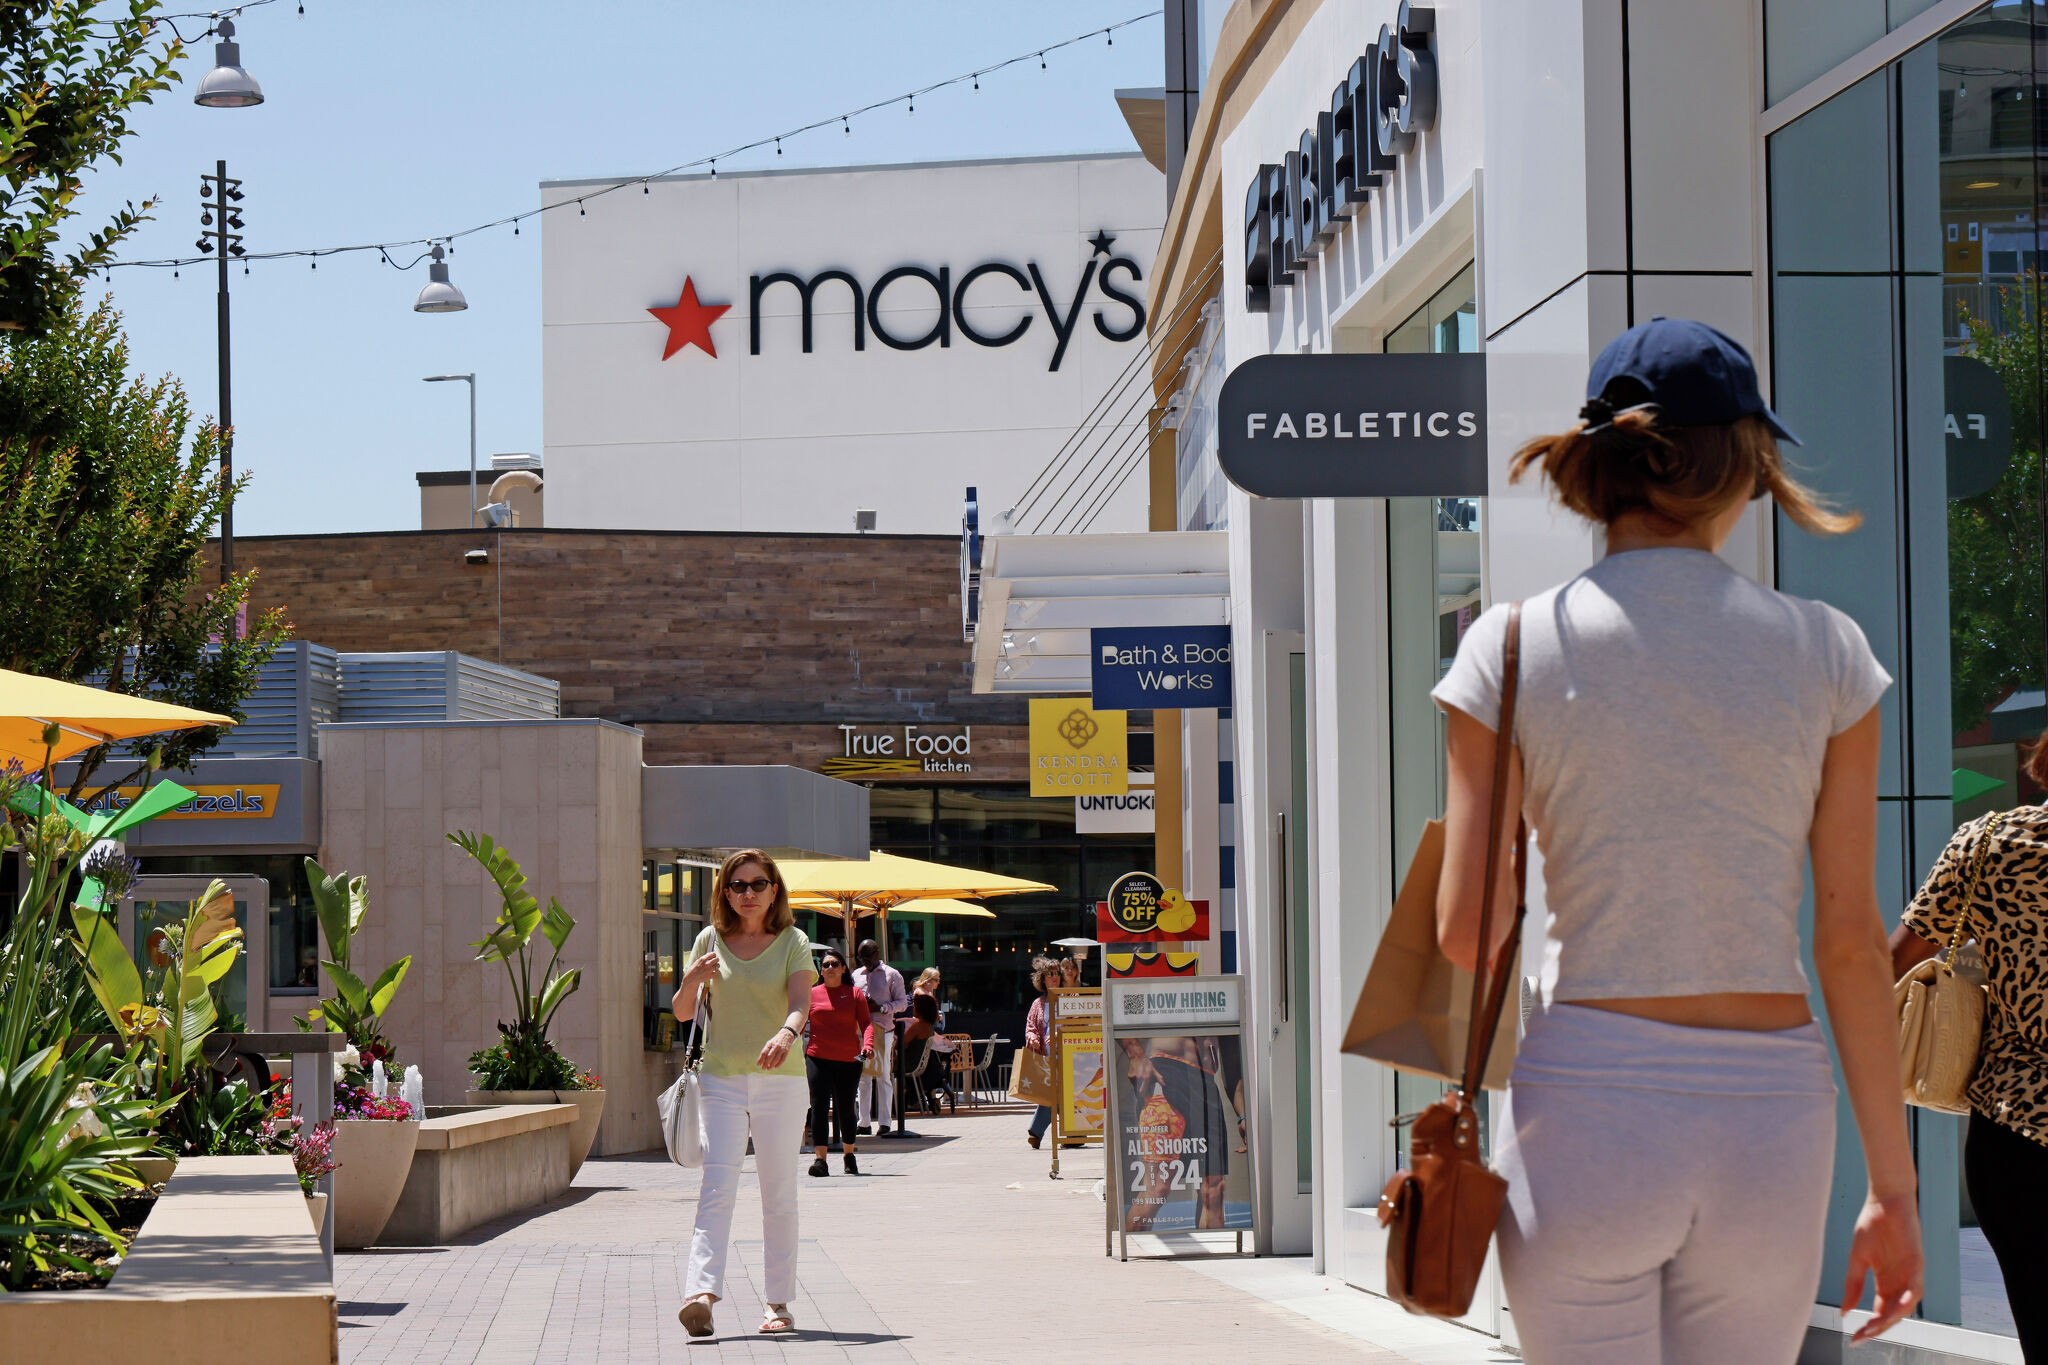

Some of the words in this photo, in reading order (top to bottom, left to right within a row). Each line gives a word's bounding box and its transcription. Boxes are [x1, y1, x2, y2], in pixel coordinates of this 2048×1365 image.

[1247, 411, 1478, 439] FABLETICS
[1102, 644, 1157, 665] Bath
[1161, 644, 1180, 665] &
[1183, 643, 1231, 664] Bod
[1137, 669, 1213, 690] Works
[838, 723, 895, 757] True
[904, 725, 971, 757] Food
[924, 757, 971, 773] kitchen
[1038, 755, 1120, 769] KENDRA
[1045, 773, 1112, 786] SCOTT
[1080, 795, 1154, 810] UNTUCKi
[1122, 892, 1156, 906] 75%
[1122, 906, 1156, 921] OFF
[1063, 1002, 1102, 1010] KENDR
[1147, 993, 1177, 1009] NOW
[1180, 991, 1226, 1007] HIRING
[1151, 1125, 1169, 1133] OFFER
[1128, 1139, 1152, 1155] ALL
[1155, 1138, 1208, 1154] SHORTS
[1130, 1161, 1147, 1191] 2
[1159, 1159, 1203, 1190] $24
